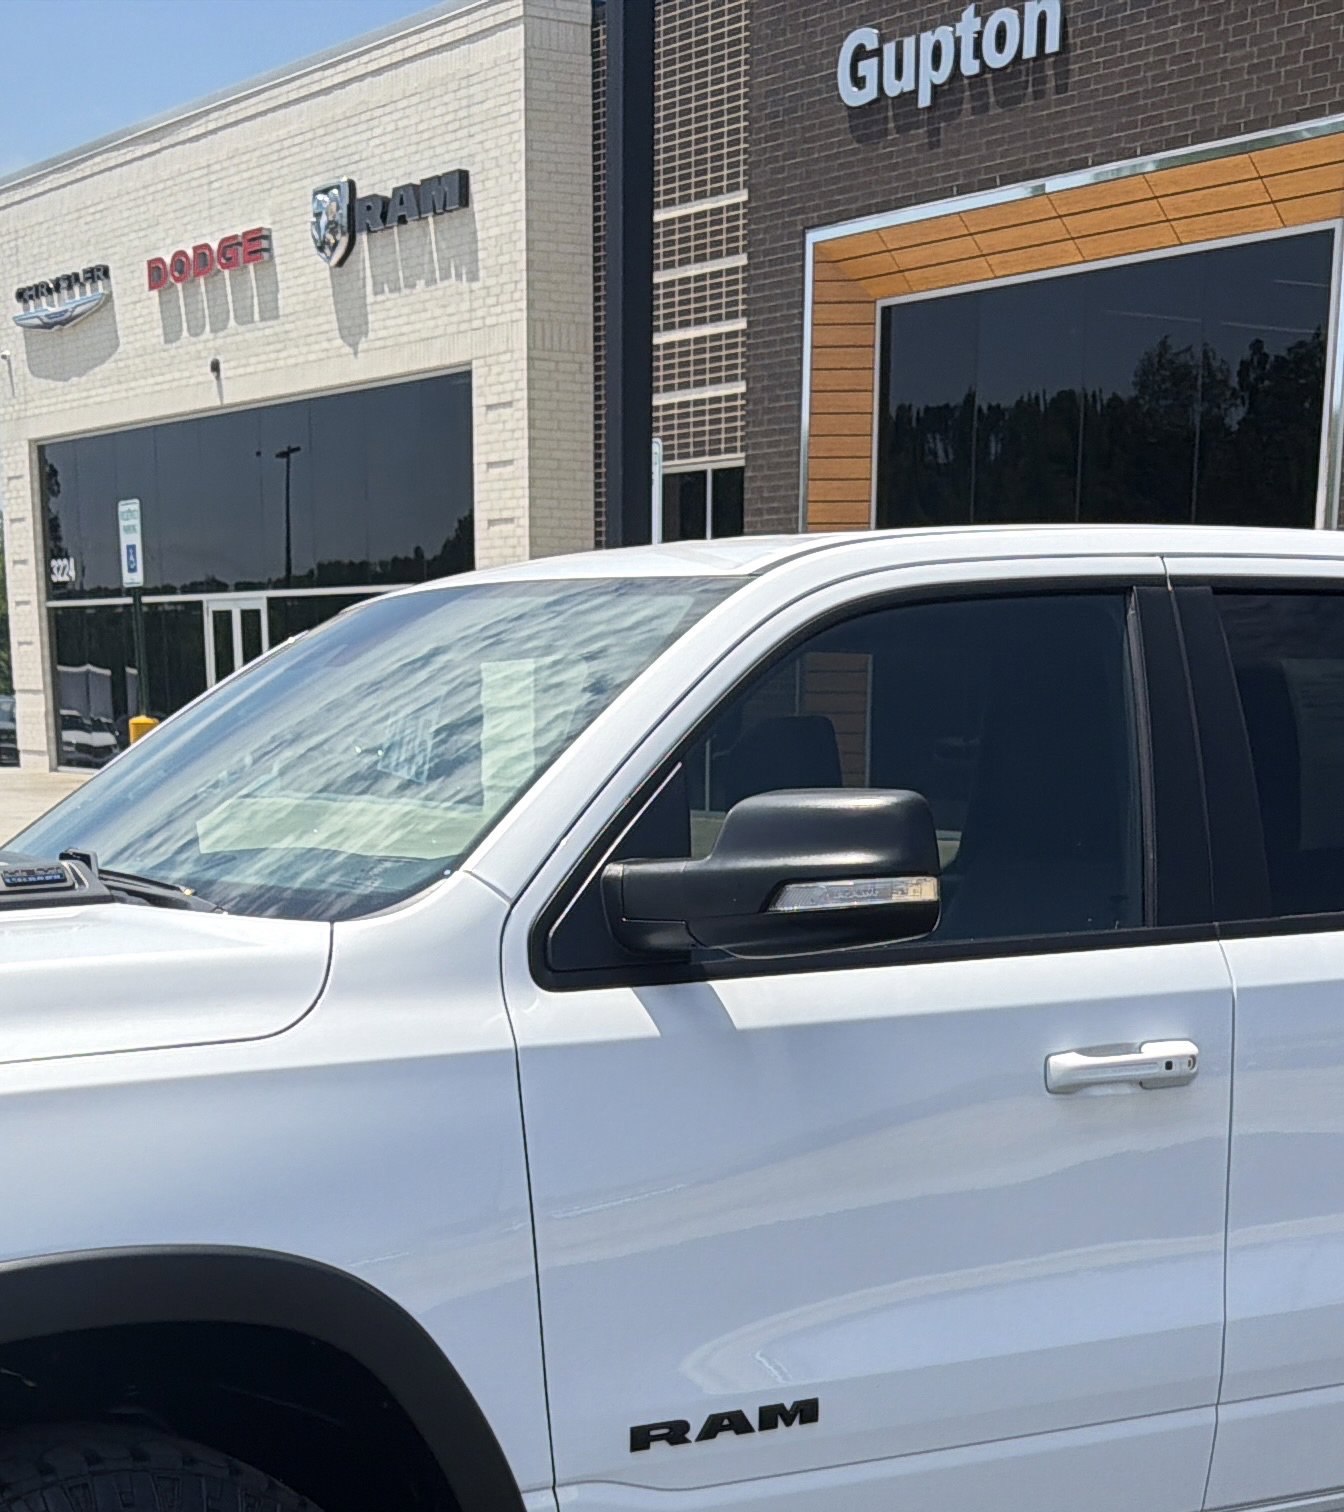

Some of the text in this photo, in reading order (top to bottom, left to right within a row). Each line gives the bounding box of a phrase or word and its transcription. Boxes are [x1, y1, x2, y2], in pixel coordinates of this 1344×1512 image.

[837, 0, 1062, 109] Gupton
[355, 169, 469, 233] RAM
[146, 226, 271, 291] DODGE
[50, 556, 76, 582] 3224
[629, 1397, 820, 1453] RAM
